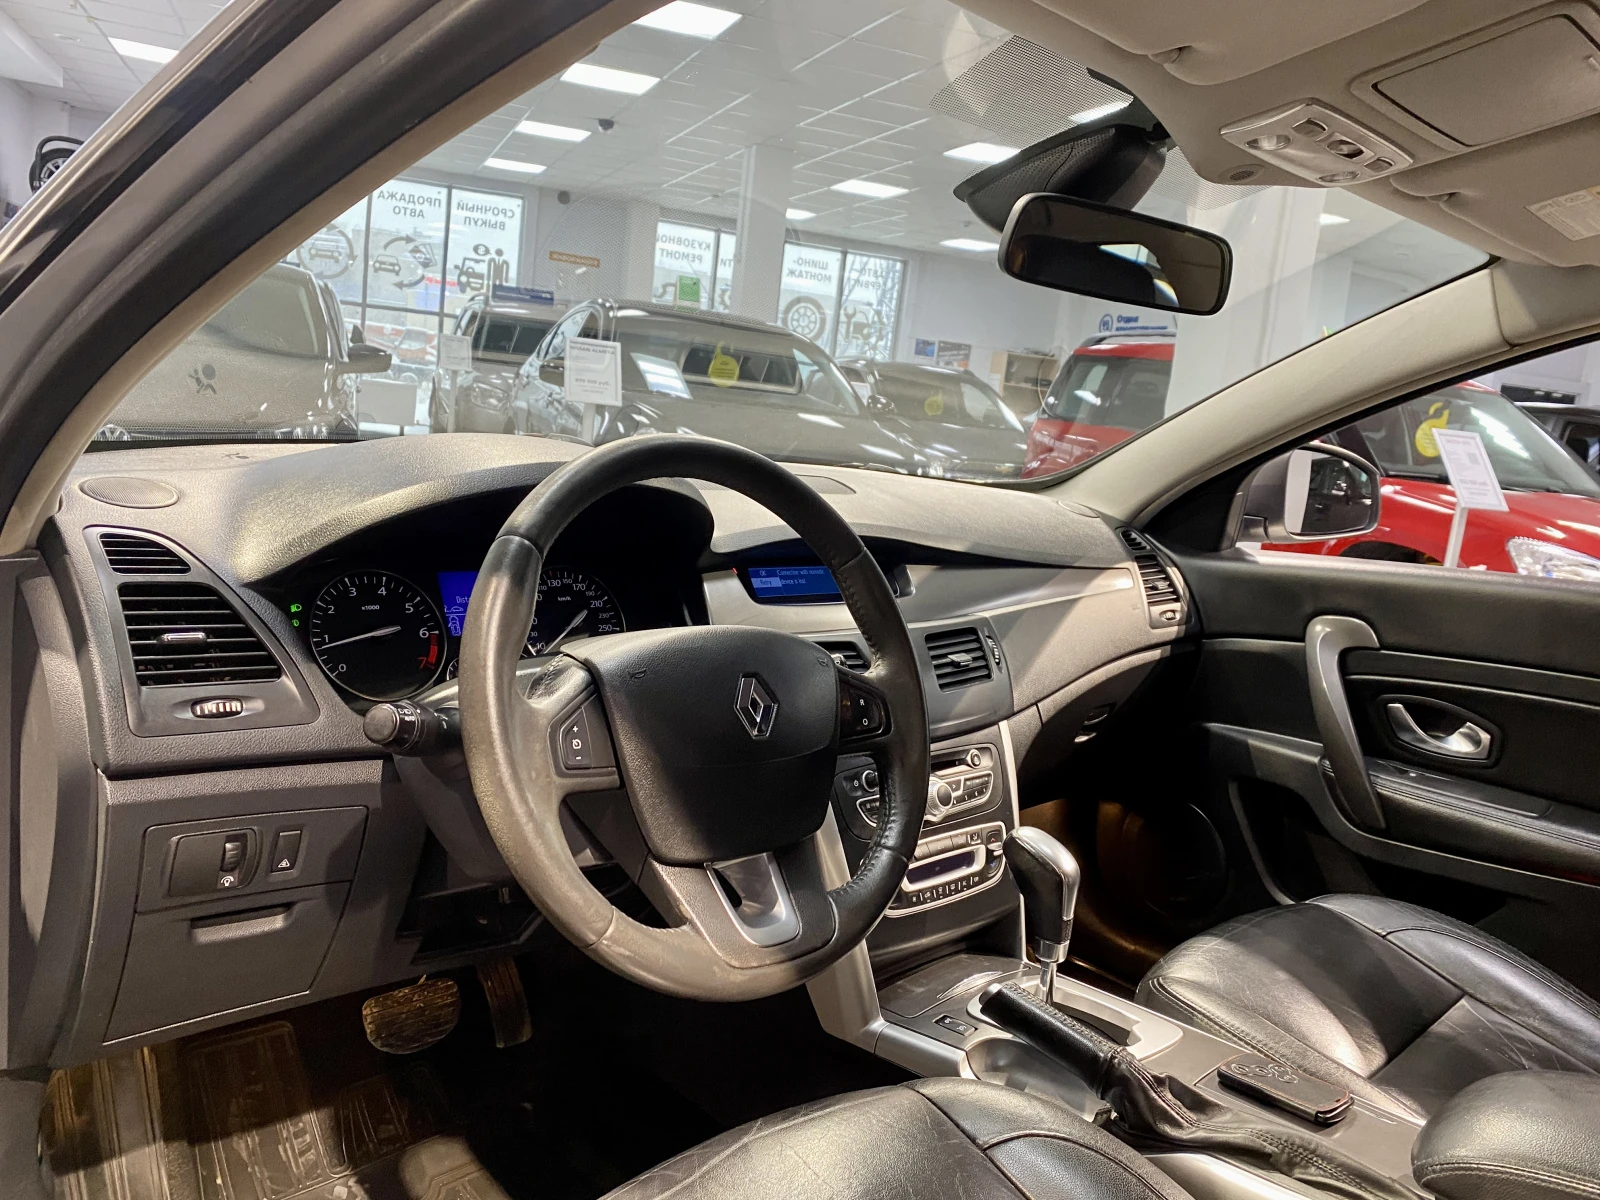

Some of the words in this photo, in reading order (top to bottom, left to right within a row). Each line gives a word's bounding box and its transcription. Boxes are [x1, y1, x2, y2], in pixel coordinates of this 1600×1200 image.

[547, 579, 562, 587] 130
[573, 583, 586, 591] 170
[349, 587, 357, 597] 3
[377, 586, 387, 596] 4
[405, 603, 414, 613] 5
[590, 600, 603, 608] 210
[328, 605, 335, 614] 2
[598, 624, 613, 632] 250
[419, 628, 429, 638] 6
[536, 642, 546, 650] 10
[418, 656, 427, 668] 7
[338, 663, 346, 672] 0
